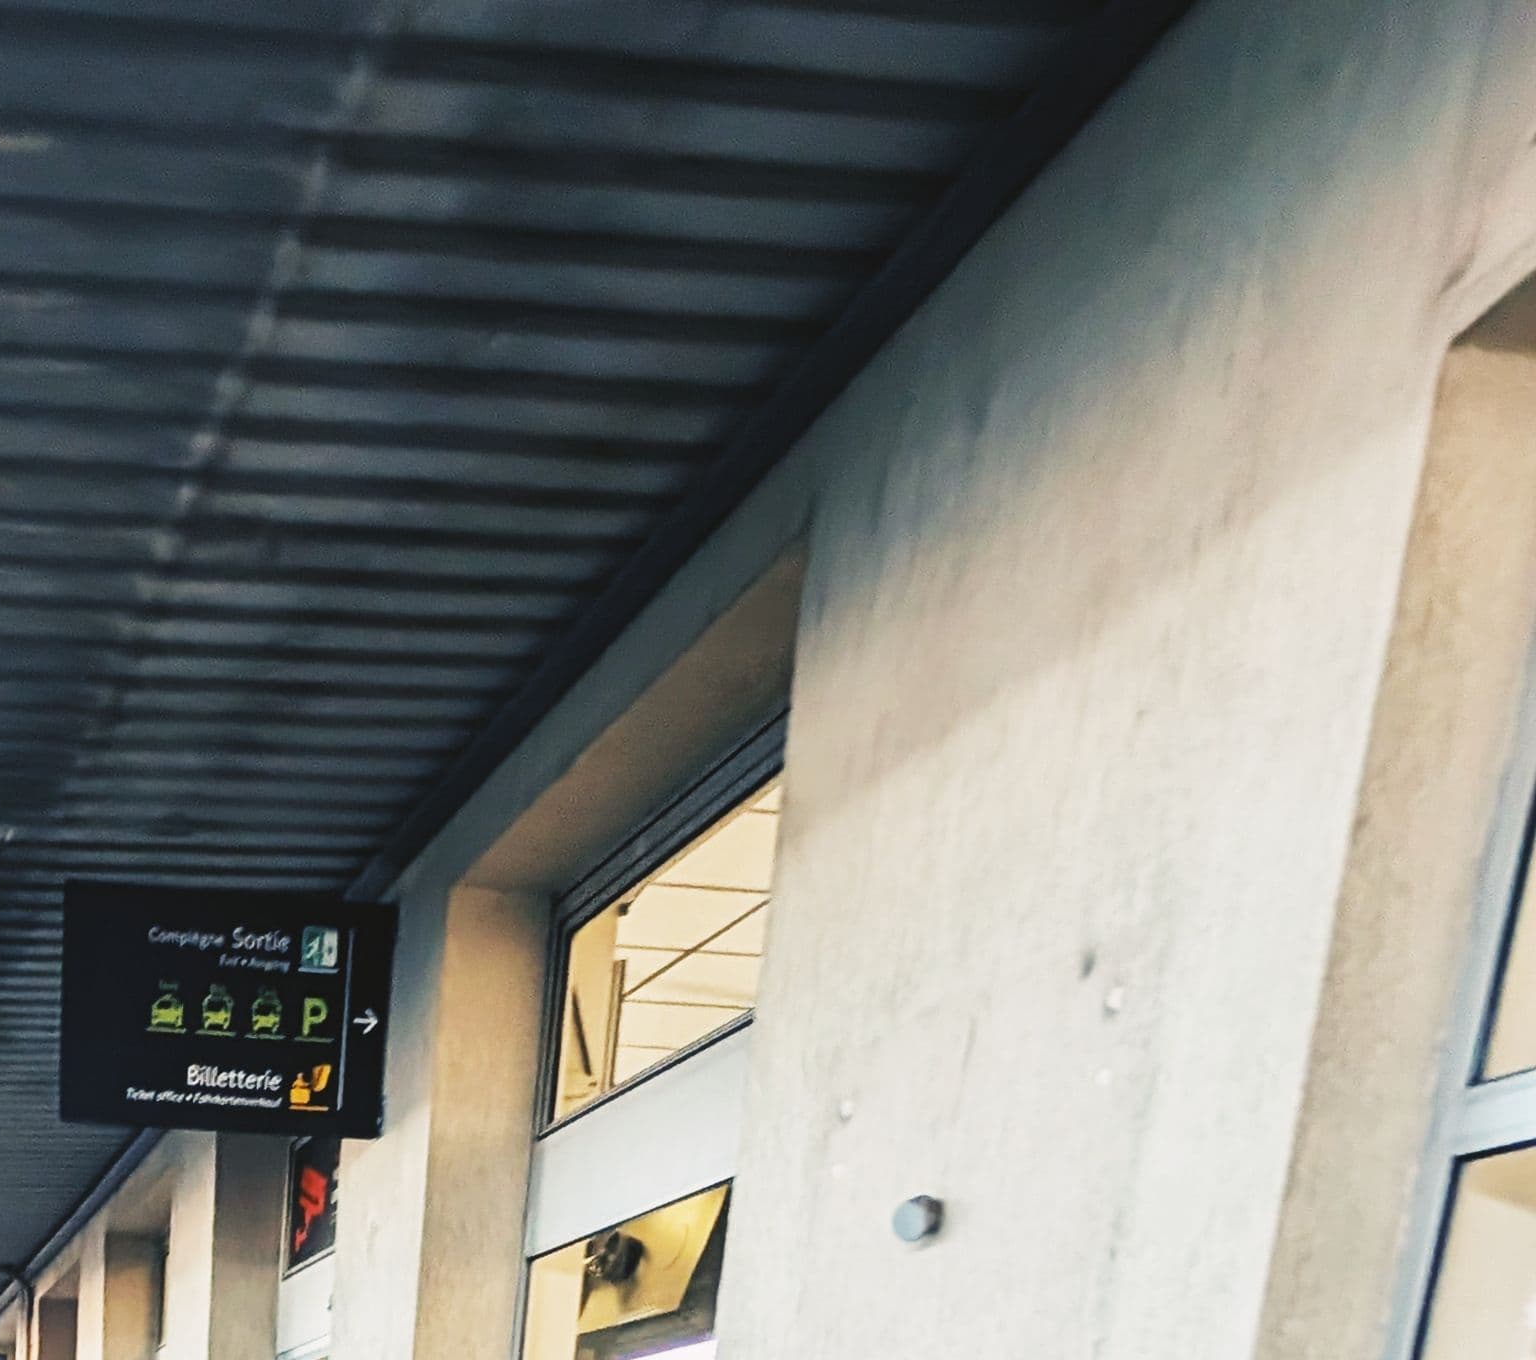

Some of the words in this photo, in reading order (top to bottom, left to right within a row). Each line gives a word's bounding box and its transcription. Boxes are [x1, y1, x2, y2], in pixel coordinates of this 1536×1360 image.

[232, 925, 291, 953] Sortie
[302, 997, 328, 1037] P
[186, 1063, 283, 1092] Billetterie
